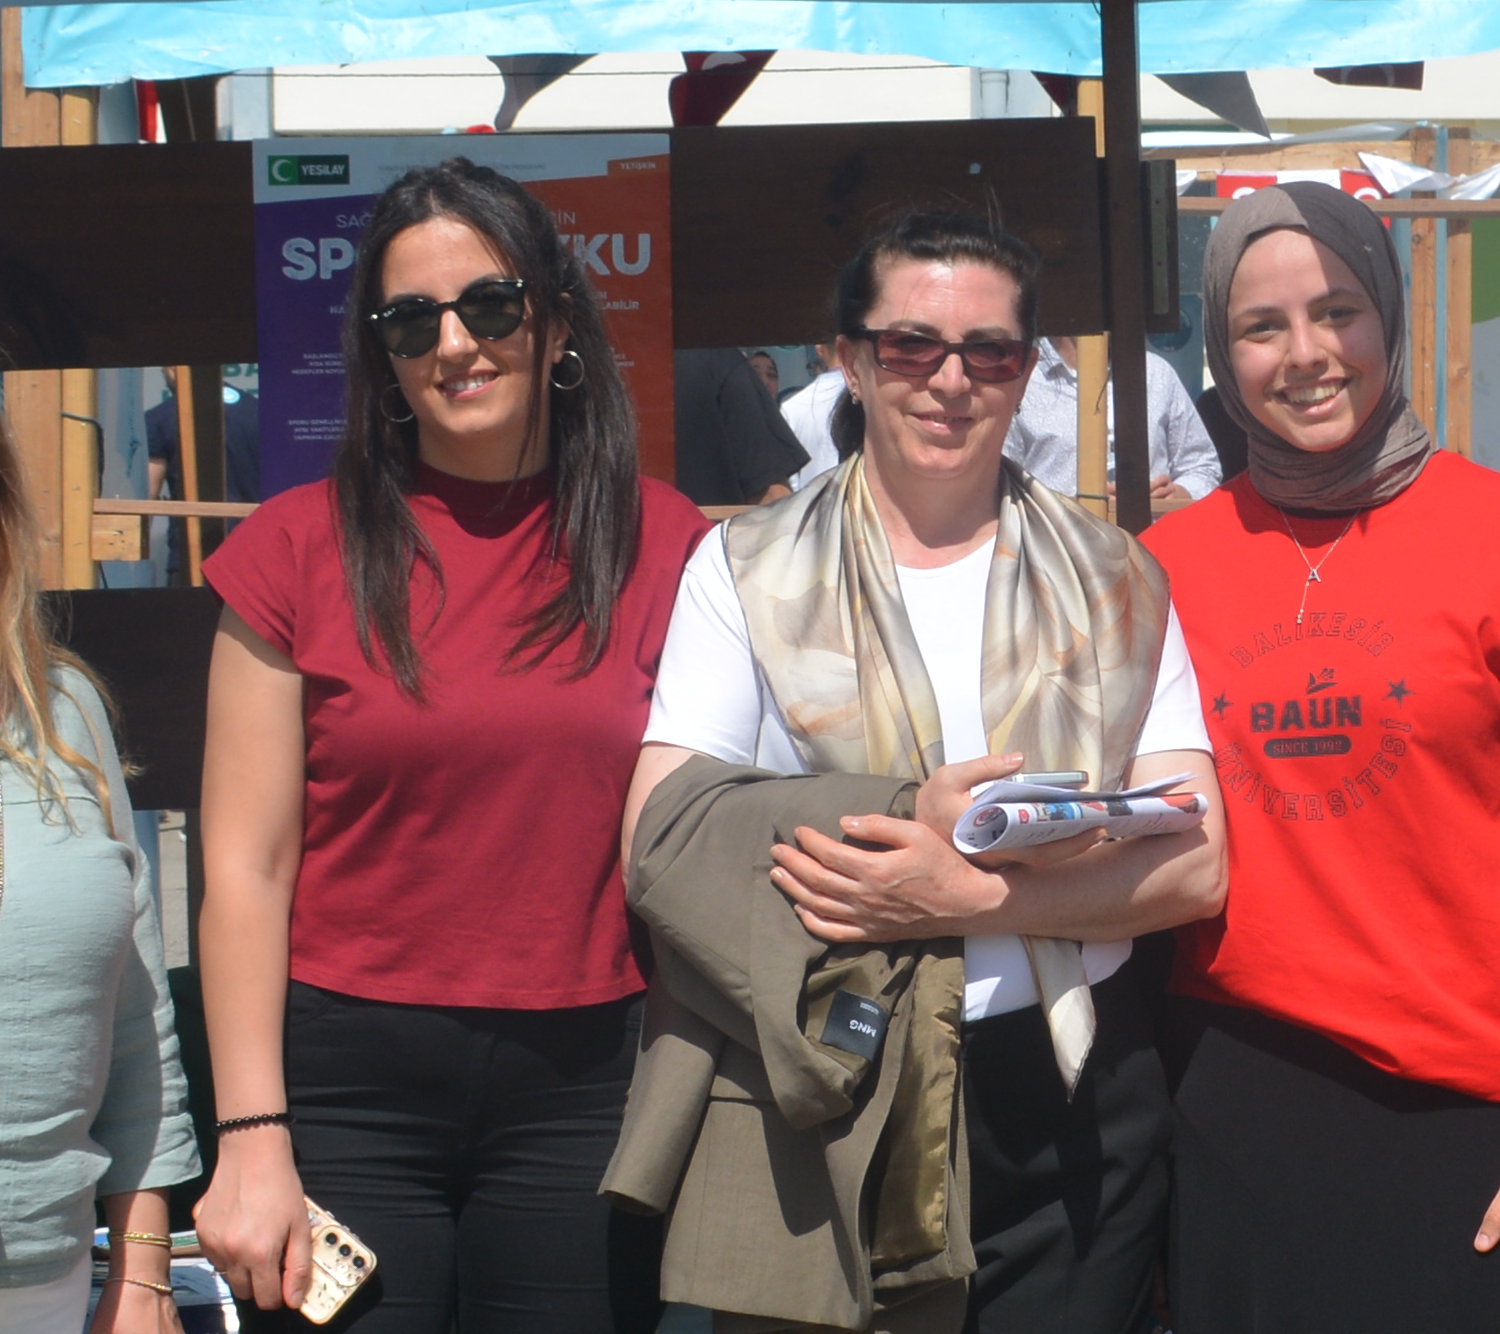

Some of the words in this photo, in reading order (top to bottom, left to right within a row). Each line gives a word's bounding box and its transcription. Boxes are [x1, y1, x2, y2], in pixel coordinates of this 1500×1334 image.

[1229, 612, 1394, 669] BALIKESİR
[1215, 718, 1412, 820] ÜNİVERSİTESİ
[1273, 742, 1308, 754] SINCE
[1314, 740, 1343, 752] 1992
